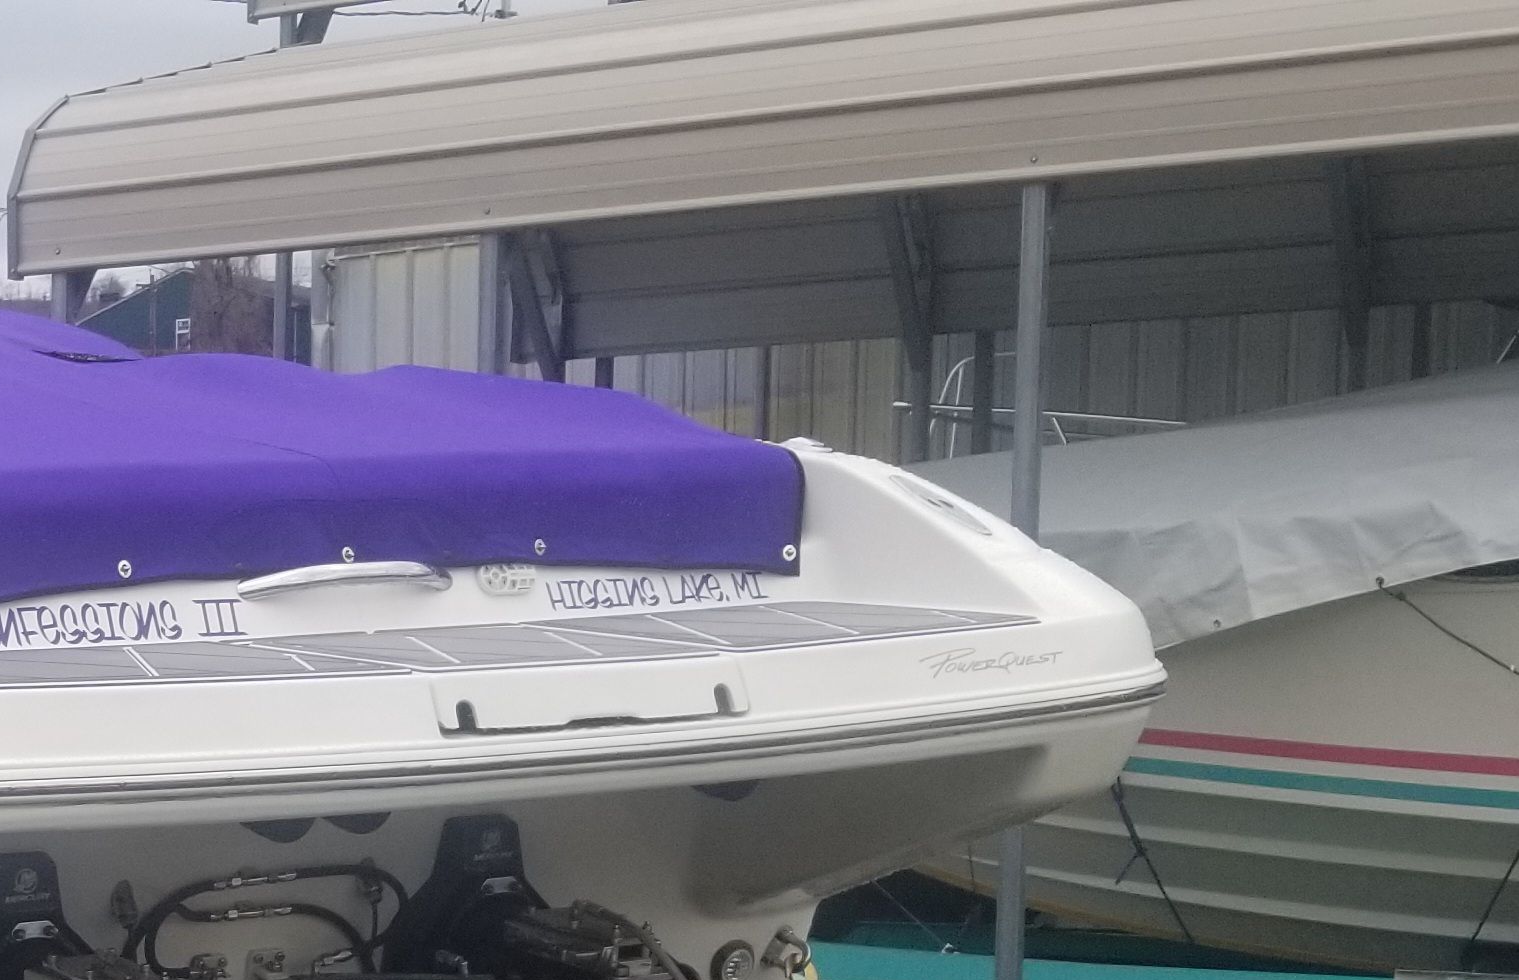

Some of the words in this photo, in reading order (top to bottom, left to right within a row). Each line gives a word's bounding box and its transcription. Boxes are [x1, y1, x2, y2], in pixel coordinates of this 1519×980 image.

[545, 576, 660, 611] HIGGINS
[730, 571, 769, 600] MI
[192, 598, 249, 637] III
